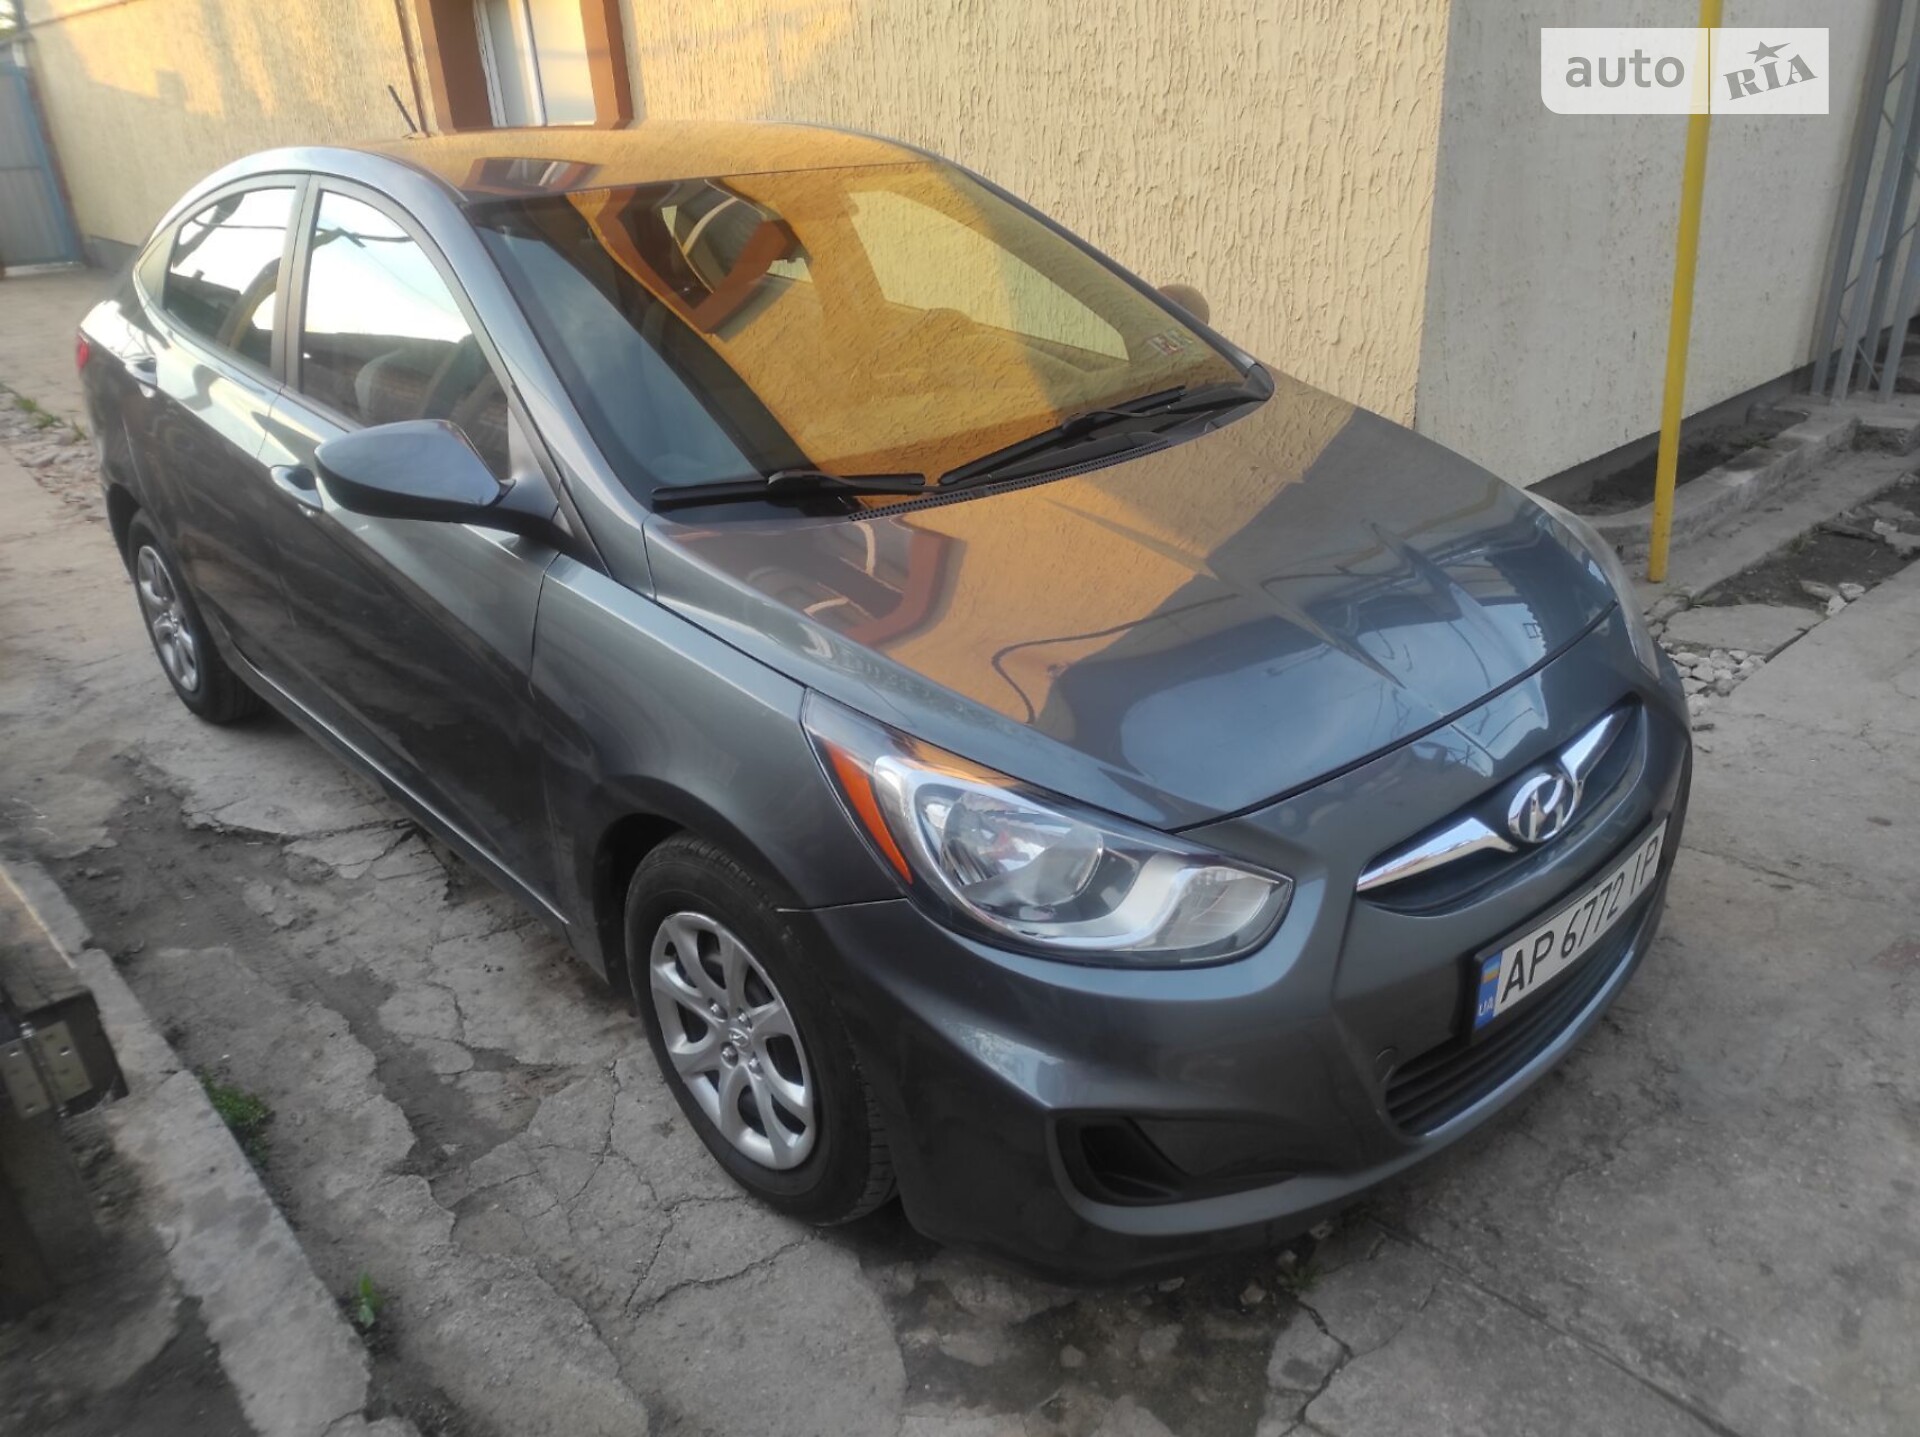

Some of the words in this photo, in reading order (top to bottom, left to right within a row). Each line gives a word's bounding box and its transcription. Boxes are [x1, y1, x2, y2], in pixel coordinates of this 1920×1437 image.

[1500, 929, 1555, 1004] AP
[1561, 872, 1625, 959] 6772
[1630, 835, 1659, 896] IP
